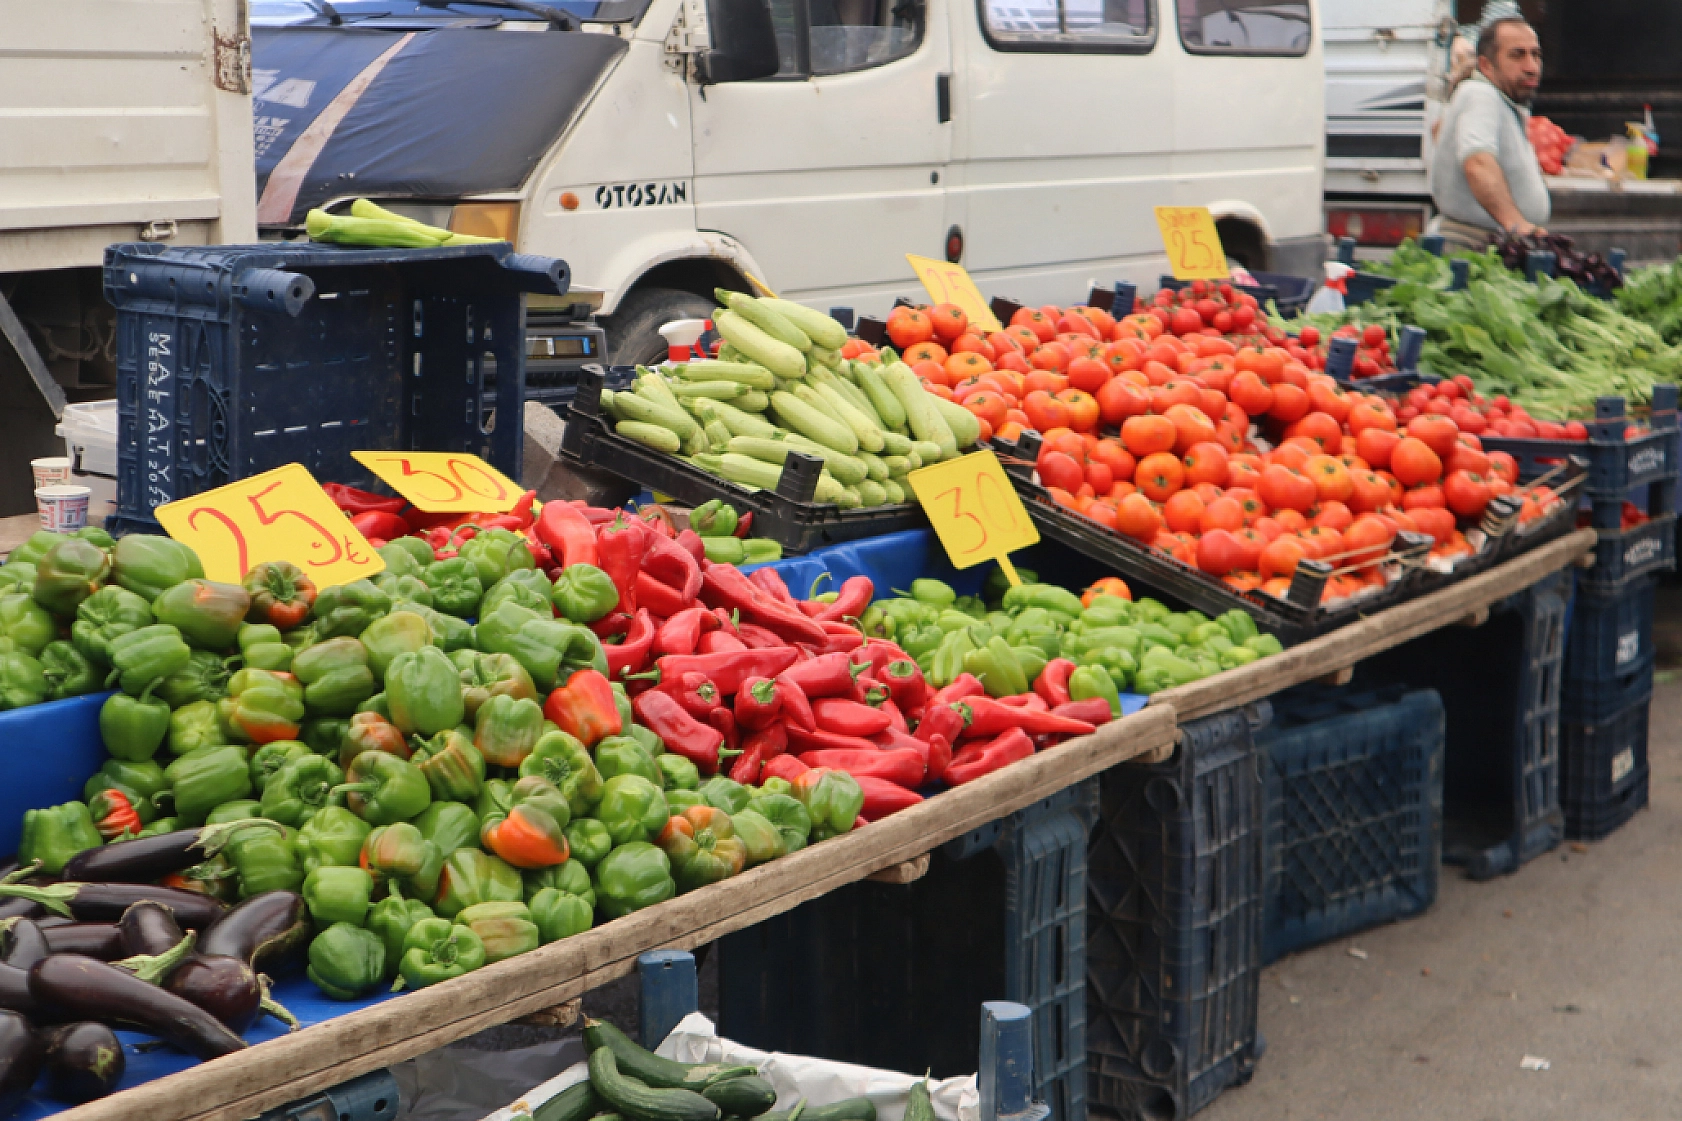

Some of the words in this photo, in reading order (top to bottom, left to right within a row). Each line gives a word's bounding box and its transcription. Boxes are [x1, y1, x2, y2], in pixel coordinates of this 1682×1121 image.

[595, 181, 685, 209] OTOSAN
[148, 332, 158, 400] SEBZE
[157, 332, 171, 506] MALATYA
